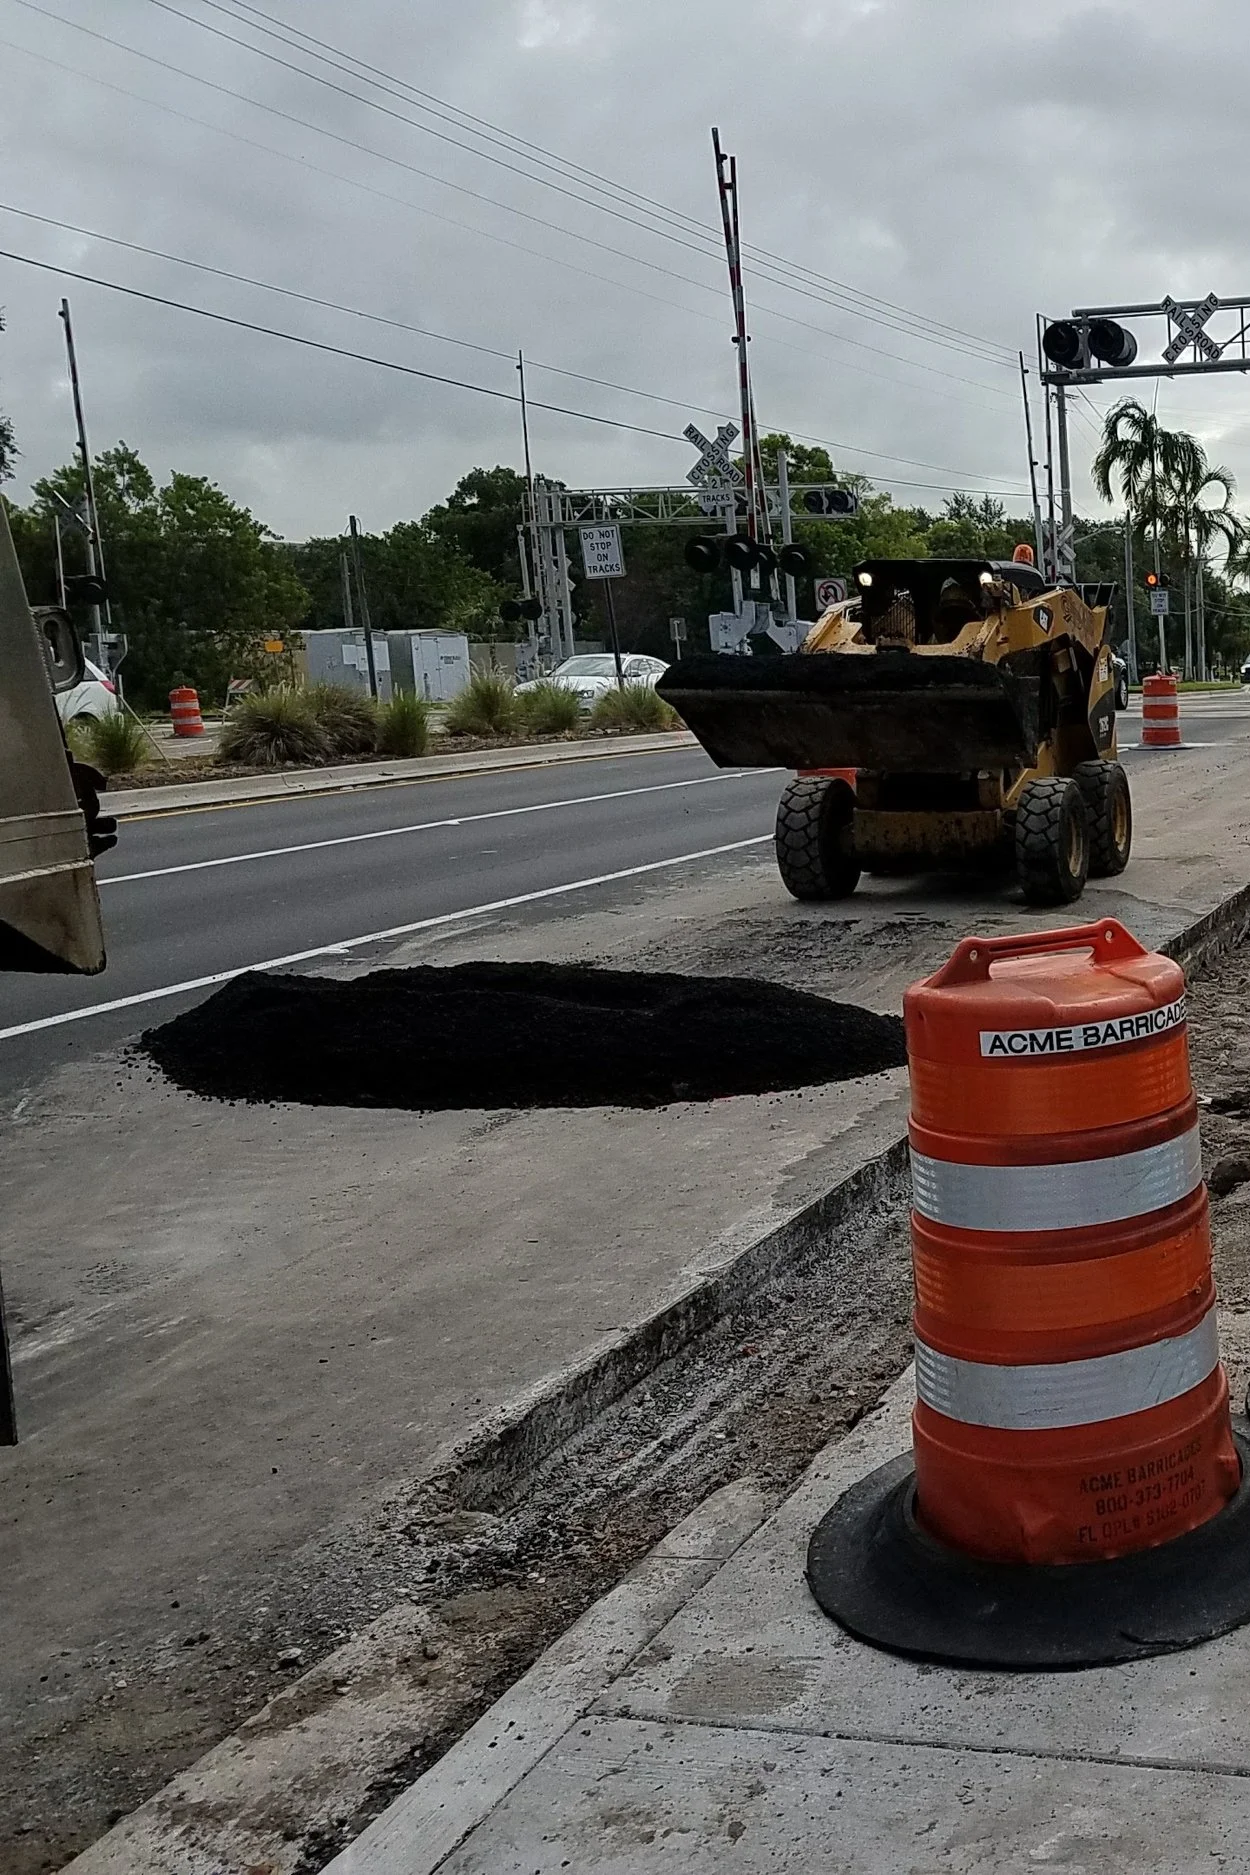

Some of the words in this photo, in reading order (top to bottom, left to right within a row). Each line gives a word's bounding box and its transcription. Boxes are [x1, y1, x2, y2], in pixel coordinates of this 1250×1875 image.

[1161, 299, 1186, 328] RAIL
[1194, 332, 1220, 359] ROAD
[1165, 296, 1218, 361] CROSSING
[685, 427, 707, 451] RAIL
[716, 458, 740, 482] ROAD
[691, 428, 735, 480] CROSSING
[711, 478, 718, 489] 2
[702, 494, 730, 503] TRACKS
[583, 532, 594, 540] DO
[598, 530, 615, 539] NOT
[590, 541, 612, 551] STOP
[588, 563, 620, 573] TRACKS
[597, 553, 609, 562] ON
[988, 1029, 1074, 1054] ACME
[1080, 1472, 1123, 1495] ACME
[1127, 1439, 1202, 1484] BARRICADES
[1095, 1465, 1194, 1516] 800-373-7704
[1078, 1525, 1098, 1543] FL
